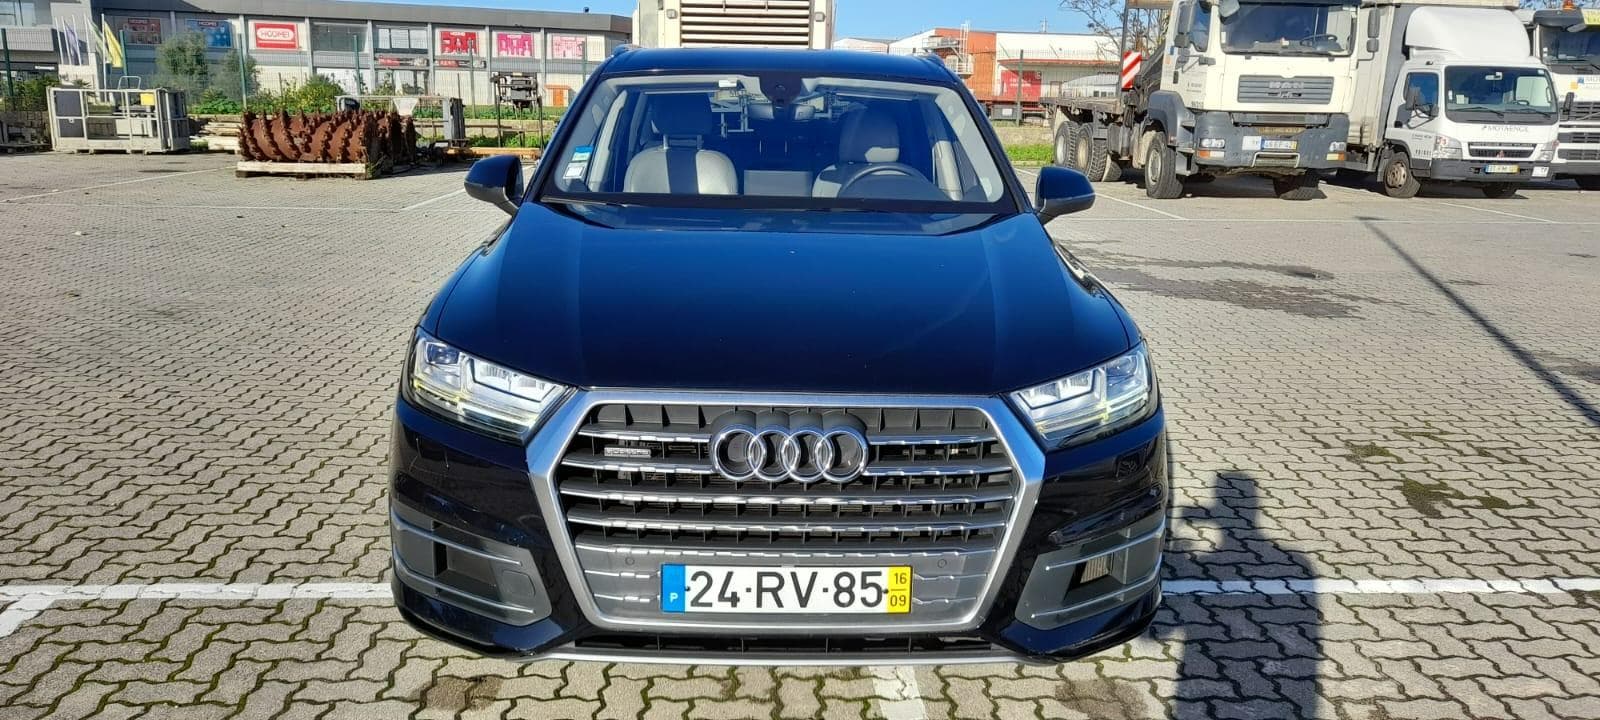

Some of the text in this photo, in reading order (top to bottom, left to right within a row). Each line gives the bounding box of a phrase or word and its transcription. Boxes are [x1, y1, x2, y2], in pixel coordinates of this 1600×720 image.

[1268, 80, 1304, 90] MAN
[893, 572, 908, 585] 16
[669, 592, 678, 603] P
[889, 594, 907, 607] 09
